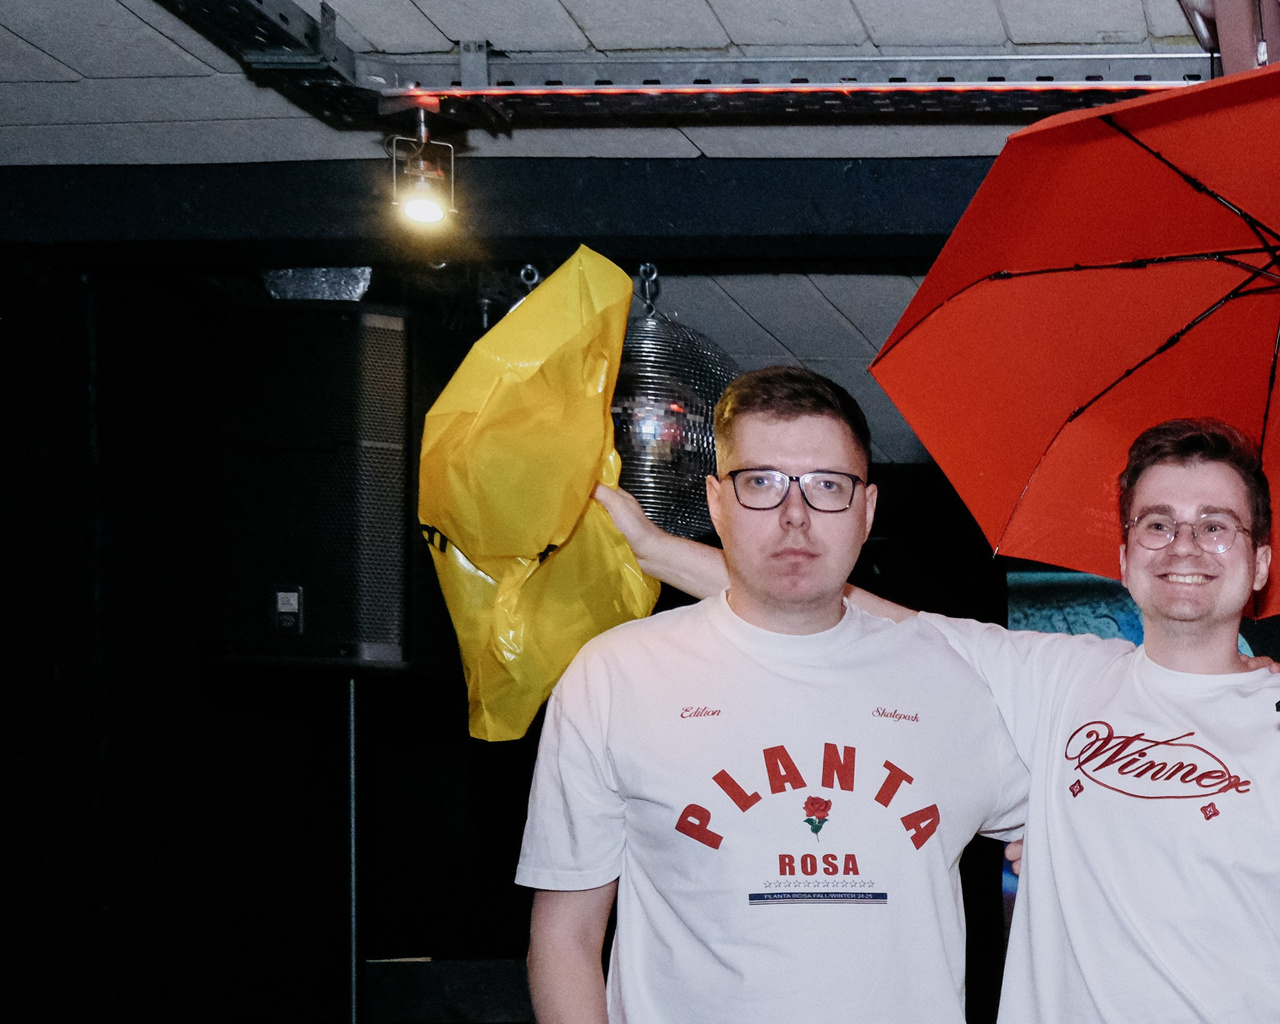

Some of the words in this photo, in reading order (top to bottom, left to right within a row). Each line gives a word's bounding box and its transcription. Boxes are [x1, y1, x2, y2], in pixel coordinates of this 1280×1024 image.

[680, 706, 721, 719] Edition
[871, 706, 920, 722] Skatepark
[1065, 721, 1251, 794] Winner
[675, 742, 941, 850] PLANTA
[778, 854, 860, 876] ROSA
